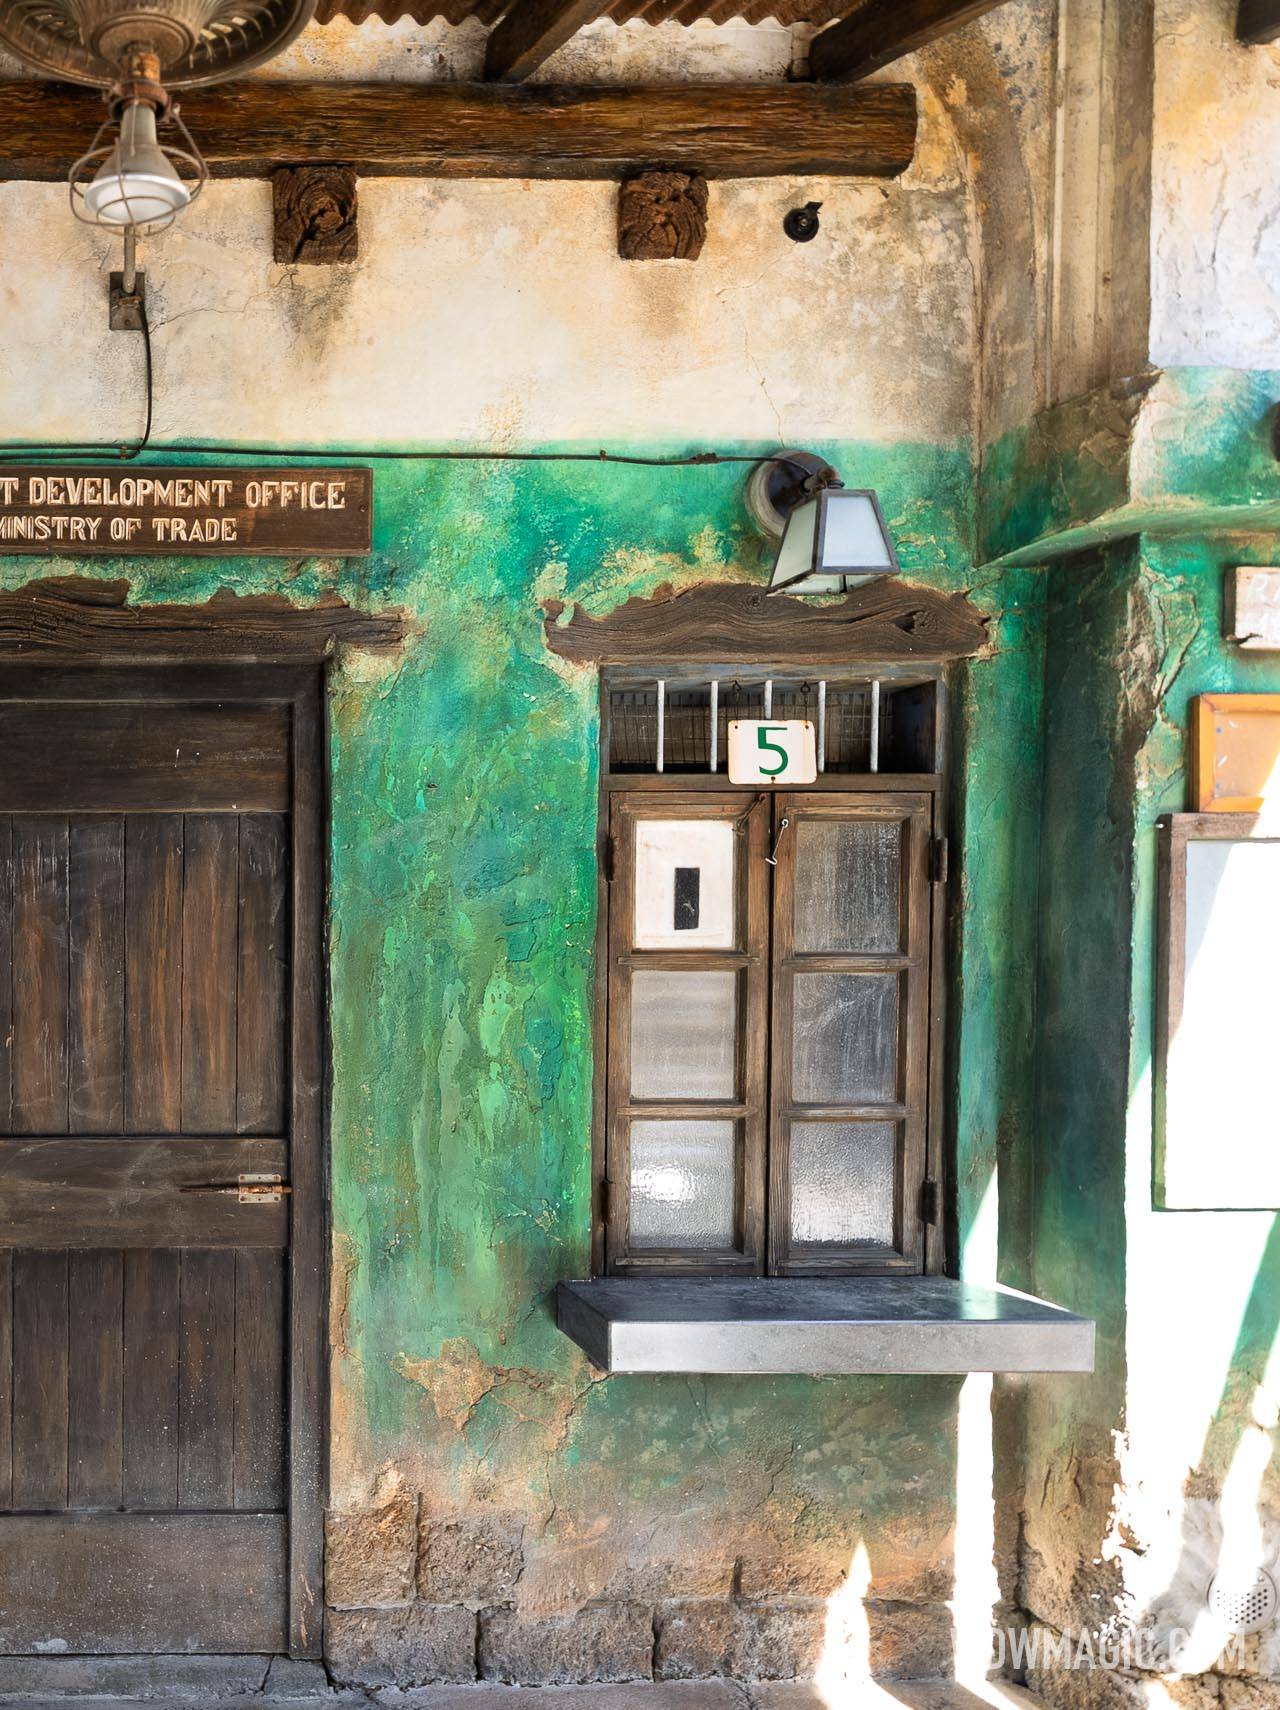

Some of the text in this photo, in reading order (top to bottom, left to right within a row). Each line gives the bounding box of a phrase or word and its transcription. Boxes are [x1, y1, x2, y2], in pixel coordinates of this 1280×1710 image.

[29, 477, 232, 508] DEVELOPMENT
[245, 481, 346, 510] OFFICE
[110, 517, 142, 541] OF
[152, 518, 238, 542] TRADE
[757, 726, 789, 775] 5
